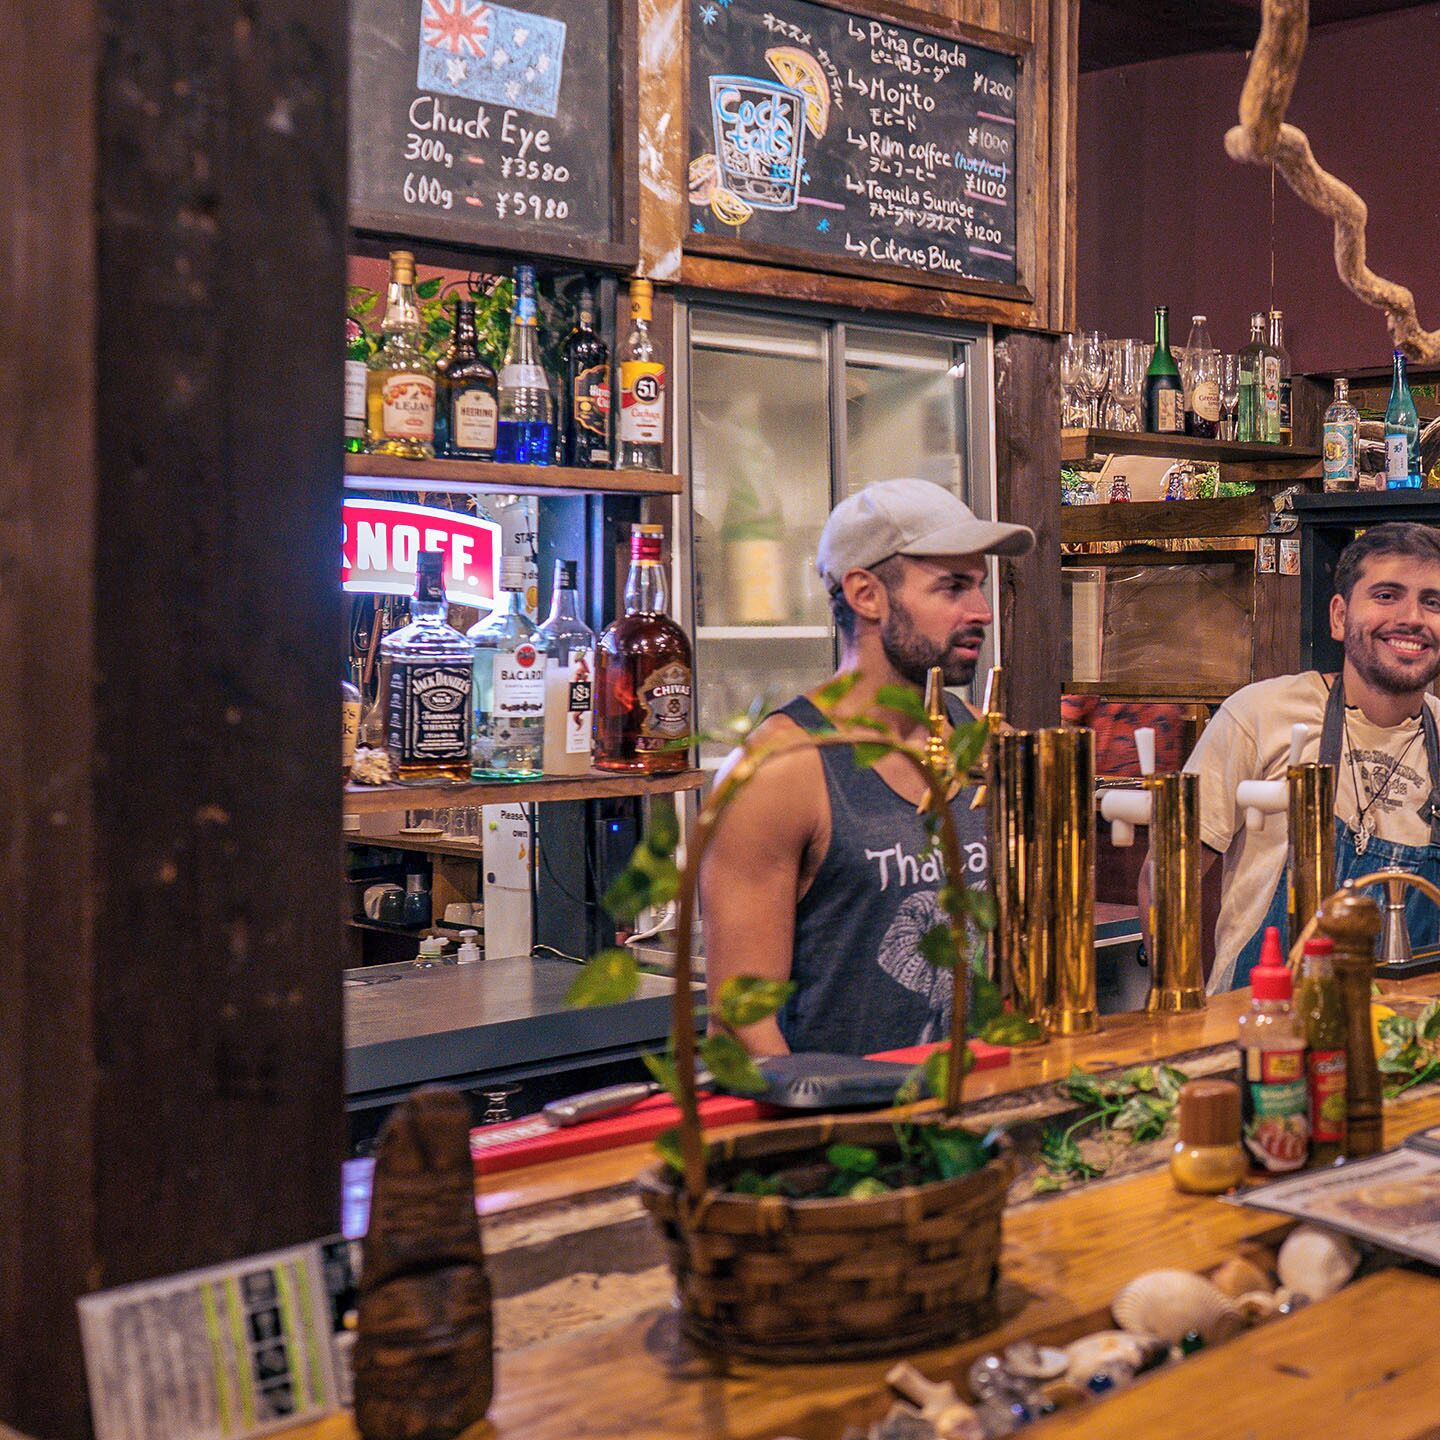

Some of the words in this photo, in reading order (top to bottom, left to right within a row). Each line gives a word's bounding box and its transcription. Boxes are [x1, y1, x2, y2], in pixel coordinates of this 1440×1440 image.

[869, 22, 909, 54] Piña
[913, 38, 966, 68] Colada
[870, 77, 936, 116] Mojito
[973, 72, 1013, 100] ¥1200
[408, 96, 490, 139] Chuck
[501, 109, 552, 158] Eye
[716, 87, 792, 131] Cock
[404, 133, 454, 168] 300g
[501, 156, 570, 183] ¥3580
[726, 123, 792, 157] tails
[870, 131, 905, 159] Rum
[908, 142, 951, 170] coffee
[968, 127, 1009, 154] ¥1000
[403, 172, 454, 209] 600g
[496, 192, 569, 220] ¥5980
[866, 180, 920, 209] Tequila
[965, 173, 1007, 198] ¥1100
[964, 222, 1002, 244] ¥1200
[869, 237, 927, 266] Citrus
[927, 245, 962, 273] Blue
[636, 380, 657, 399] 51
